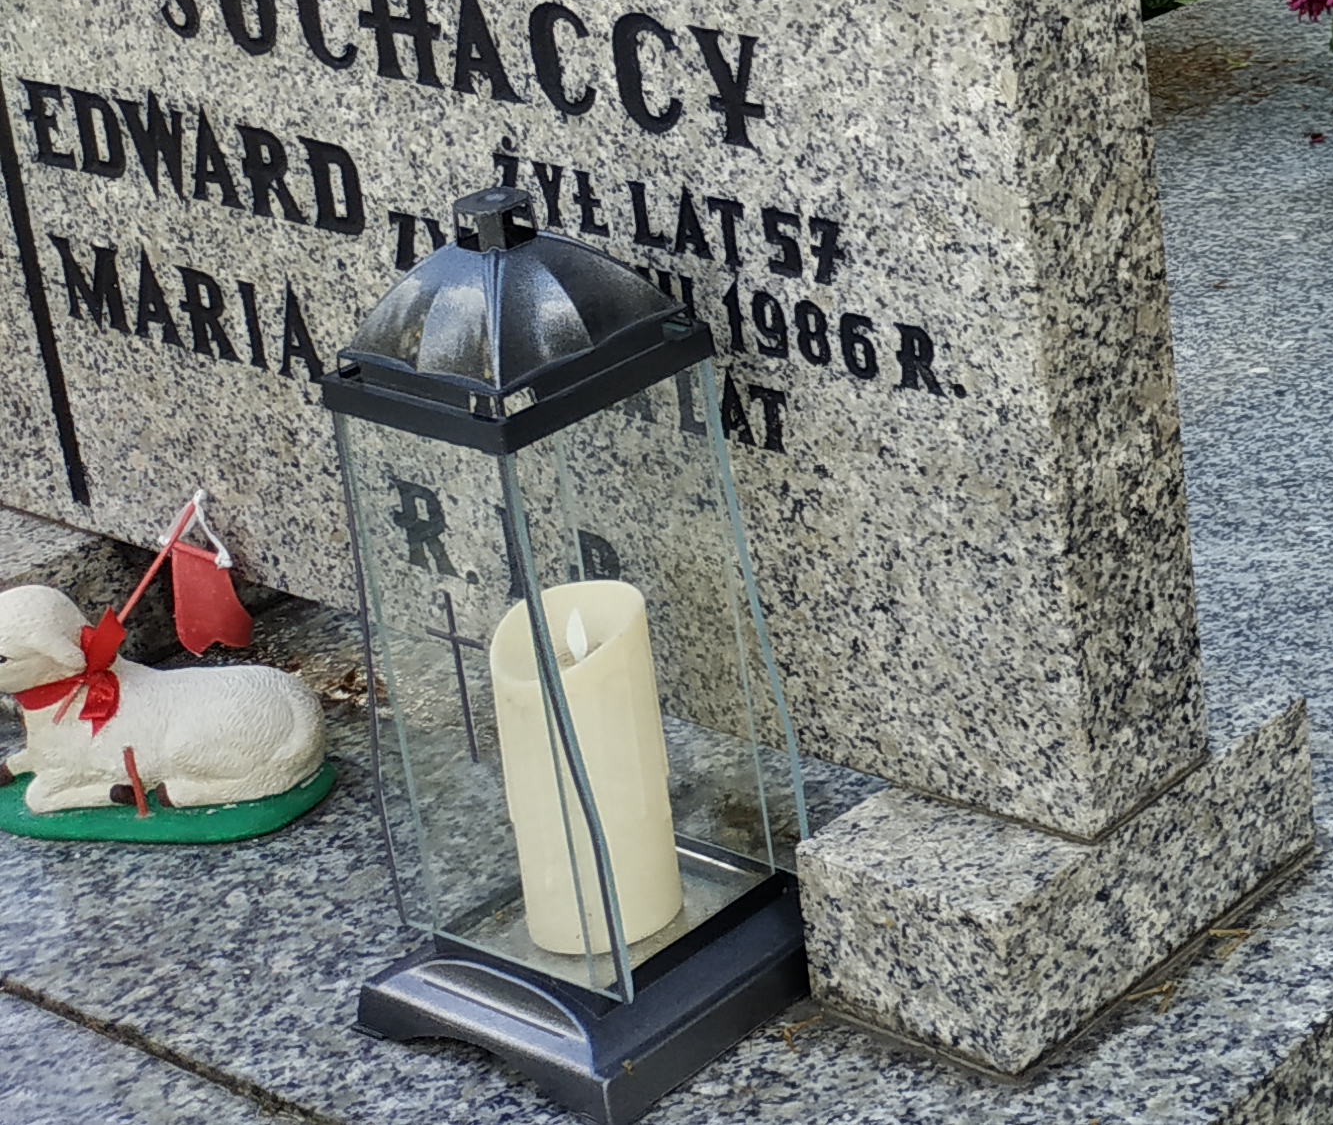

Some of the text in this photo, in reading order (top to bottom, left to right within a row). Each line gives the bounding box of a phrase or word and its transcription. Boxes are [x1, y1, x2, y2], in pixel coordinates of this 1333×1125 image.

[24, 79, 366, 237] EDWARD
[627, 179, 745, 275] LAT
[762, 204, 846, 286] 57
[47, 233, 325, 387] MARIA
[724, 281, 879, 380] 1986
[894, 320, 968, 401] R.
